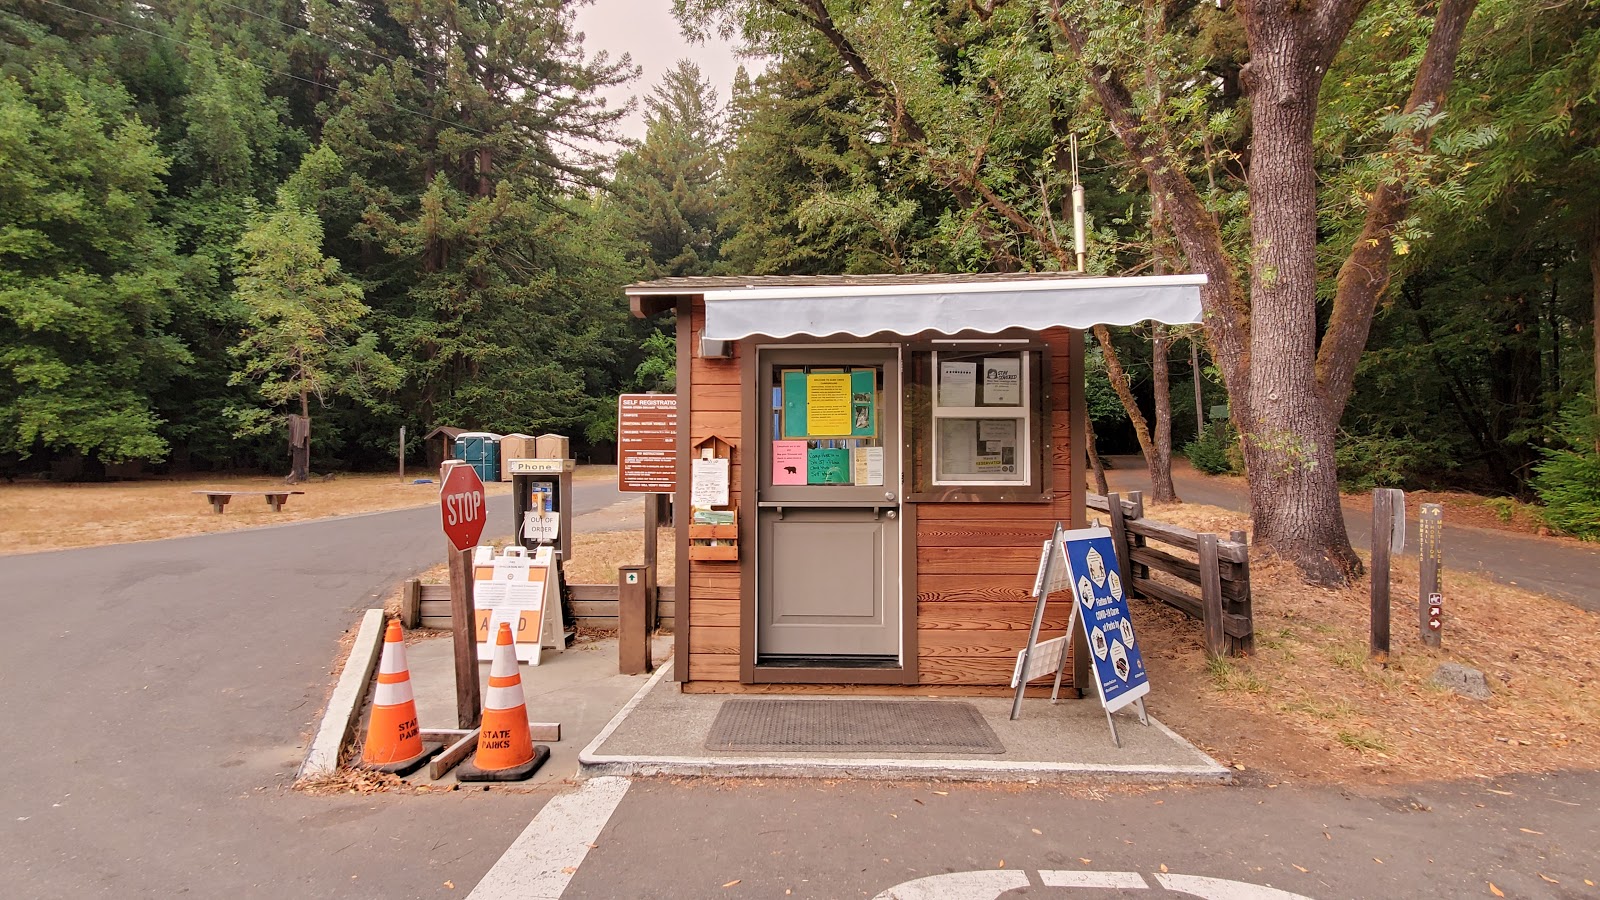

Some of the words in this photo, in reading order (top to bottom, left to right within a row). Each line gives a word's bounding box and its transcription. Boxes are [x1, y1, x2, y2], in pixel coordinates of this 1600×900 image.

[446, 490, 481, 526] STOP
[482, 729, 511, 739] STATE
[481, 740, 510, 750] PARKS
